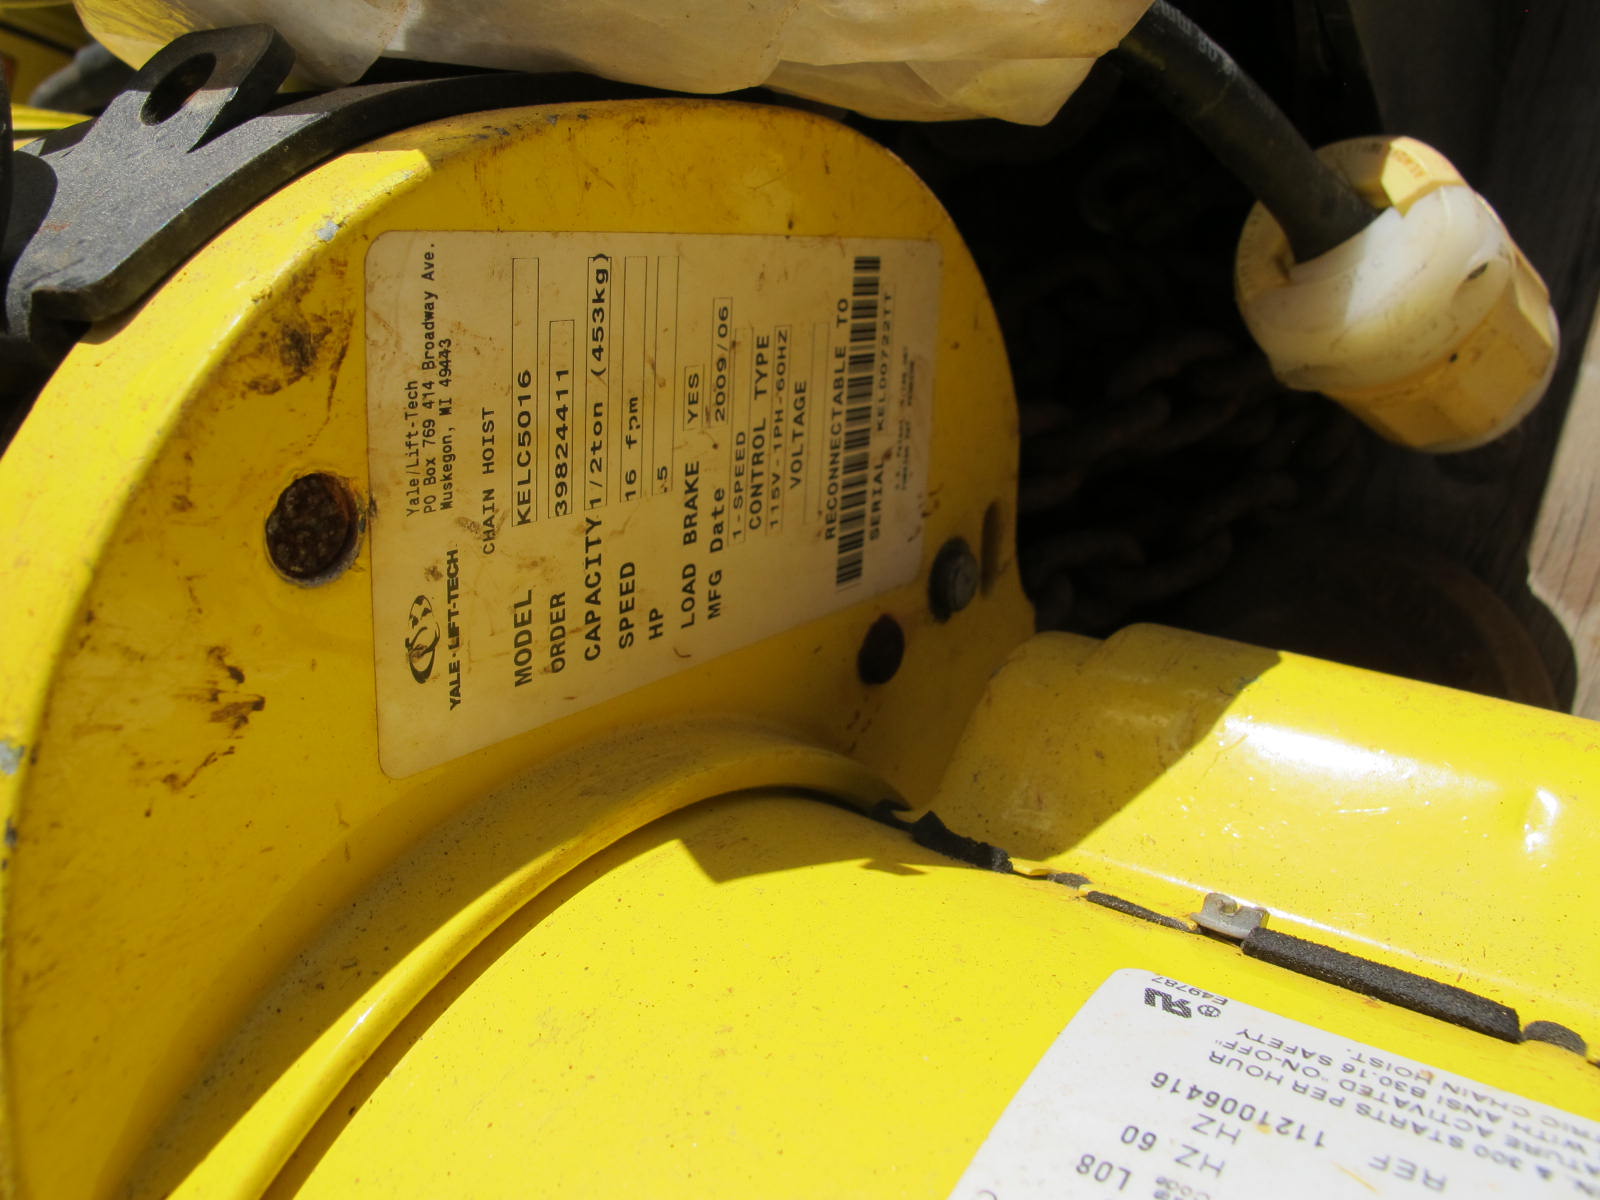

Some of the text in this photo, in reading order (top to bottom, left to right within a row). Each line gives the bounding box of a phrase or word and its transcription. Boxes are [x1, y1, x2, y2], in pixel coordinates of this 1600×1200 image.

[421, 243, 438, 513] PO Box 769 414 Broadway Ave.
[439, 338, 456, 510] Muskegon, MI 49443
[749, 335, 770, 530] CONTROL TYPE
[770, 329, 788, 528] 115V-1PH-60HZ
[790, 381, 807, 490] VOLTAGE
[825, 299, 848, 540] RECONNECTABLE TO
[404, 381, 421, 517] Yale/Lift-Tech
[482, 407, 496, 555] CHAIN HOIST
[584, 253, 609, 661] CAPACITY 1/2ton (453kg)
[681, 373, 700, 629] LOAD BRAKE YES
[707, 306, 729, 620] MFG Date 2009/06
[732, 432, 746, 539] 1-SPEED
[870, 463, 884, 540] SERIAL
[513, 370, 533, 687] MODEL KELC5016
[550, 370, 569, 673] ORDER 39824411
[618, 397, 641, 649] SPEED 16 fpm
[648, 608, 663, 640] HP
[1151, 976, 1228, 1005] E49787
[1209, 1050, 1284, 1086] HOUR
[1236, 1028, 1587, 1155] WITH ANSI B30.16 SAFETY
[1292, 1080, 1346, 1107] PER
[1338, 1079, 1494, 1138] ACTIVATED
[1347, 1048, 1433, 1085] HOIST.
[1355, 1102, 1465, 1150] STARTS
[1442, 1081, 1530, 1118] CHAIN
[1076, 1154, 1132, 1190] L08
[1120, 1125, 1225, 1178] HZ 60
[1151, 1071, 1447, 1192] REF 1121006416
[1191, 1113, 1241, 1145] HZ
